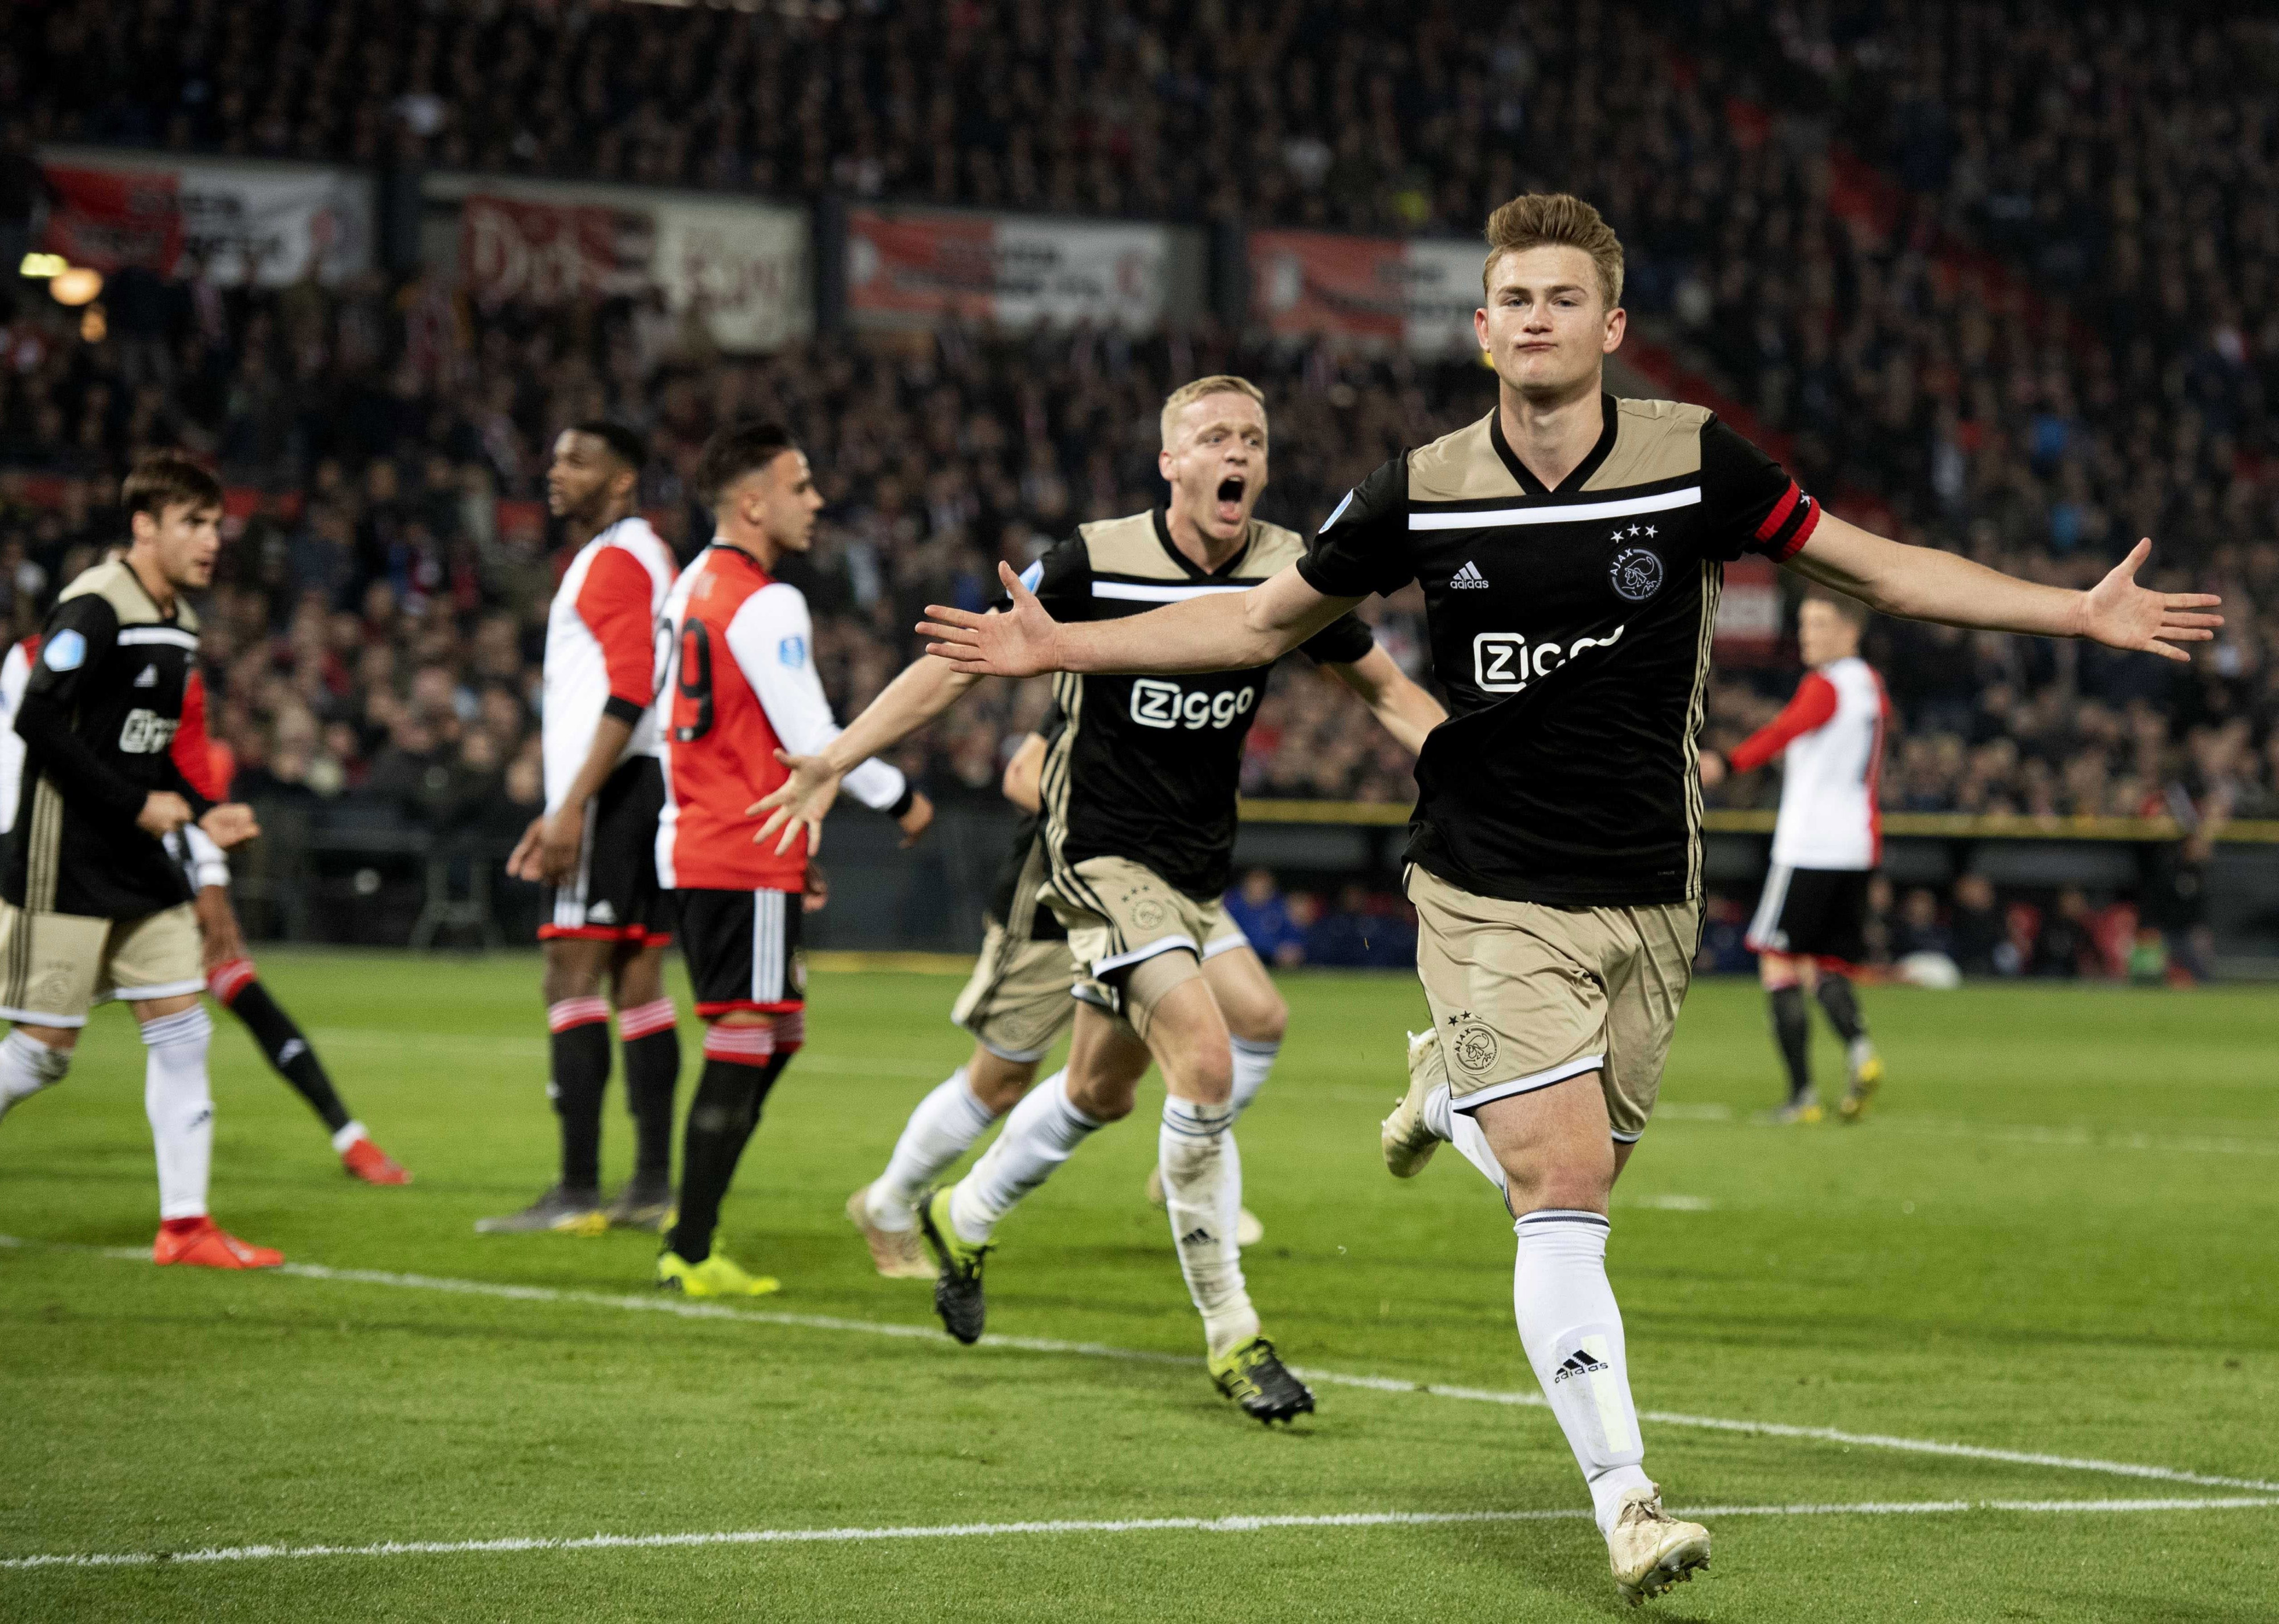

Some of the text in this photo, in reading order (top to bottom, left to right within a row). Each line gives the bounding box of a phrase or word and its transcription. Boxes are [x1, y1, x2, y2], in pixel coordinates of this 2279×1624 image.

[1610, 549, 1633, 576] AJAX
[1450, 579, 1489, 590] adidas
[1454, 1028, 1471, 1053] AJAX
[1555, 1363, 1608, 1384] adidas
